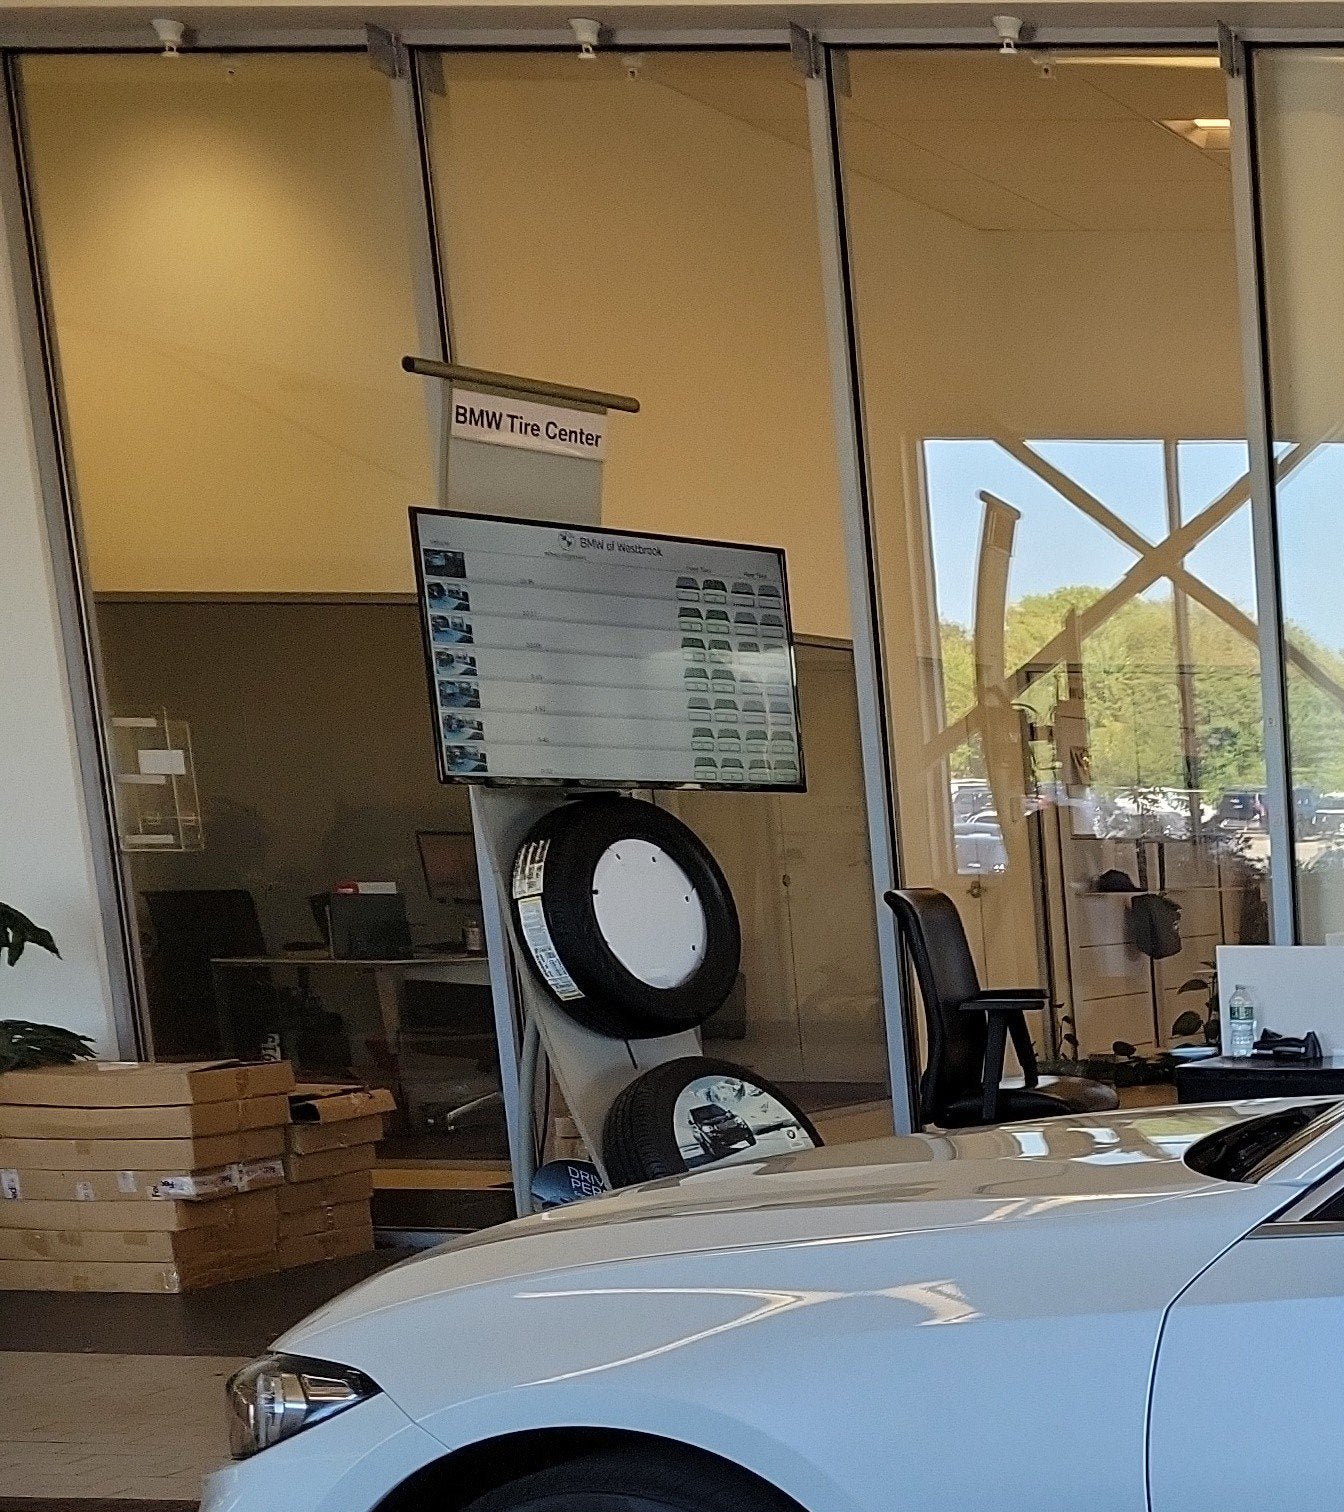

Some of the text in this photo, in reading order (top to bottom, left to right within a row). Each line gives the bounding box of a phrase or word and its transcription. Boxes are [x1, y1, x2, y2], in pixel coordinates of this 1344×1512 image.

[455, 404, 602, 448] BMW Tire Center
[579, 537, 664, 557] BMW of Westbrook
